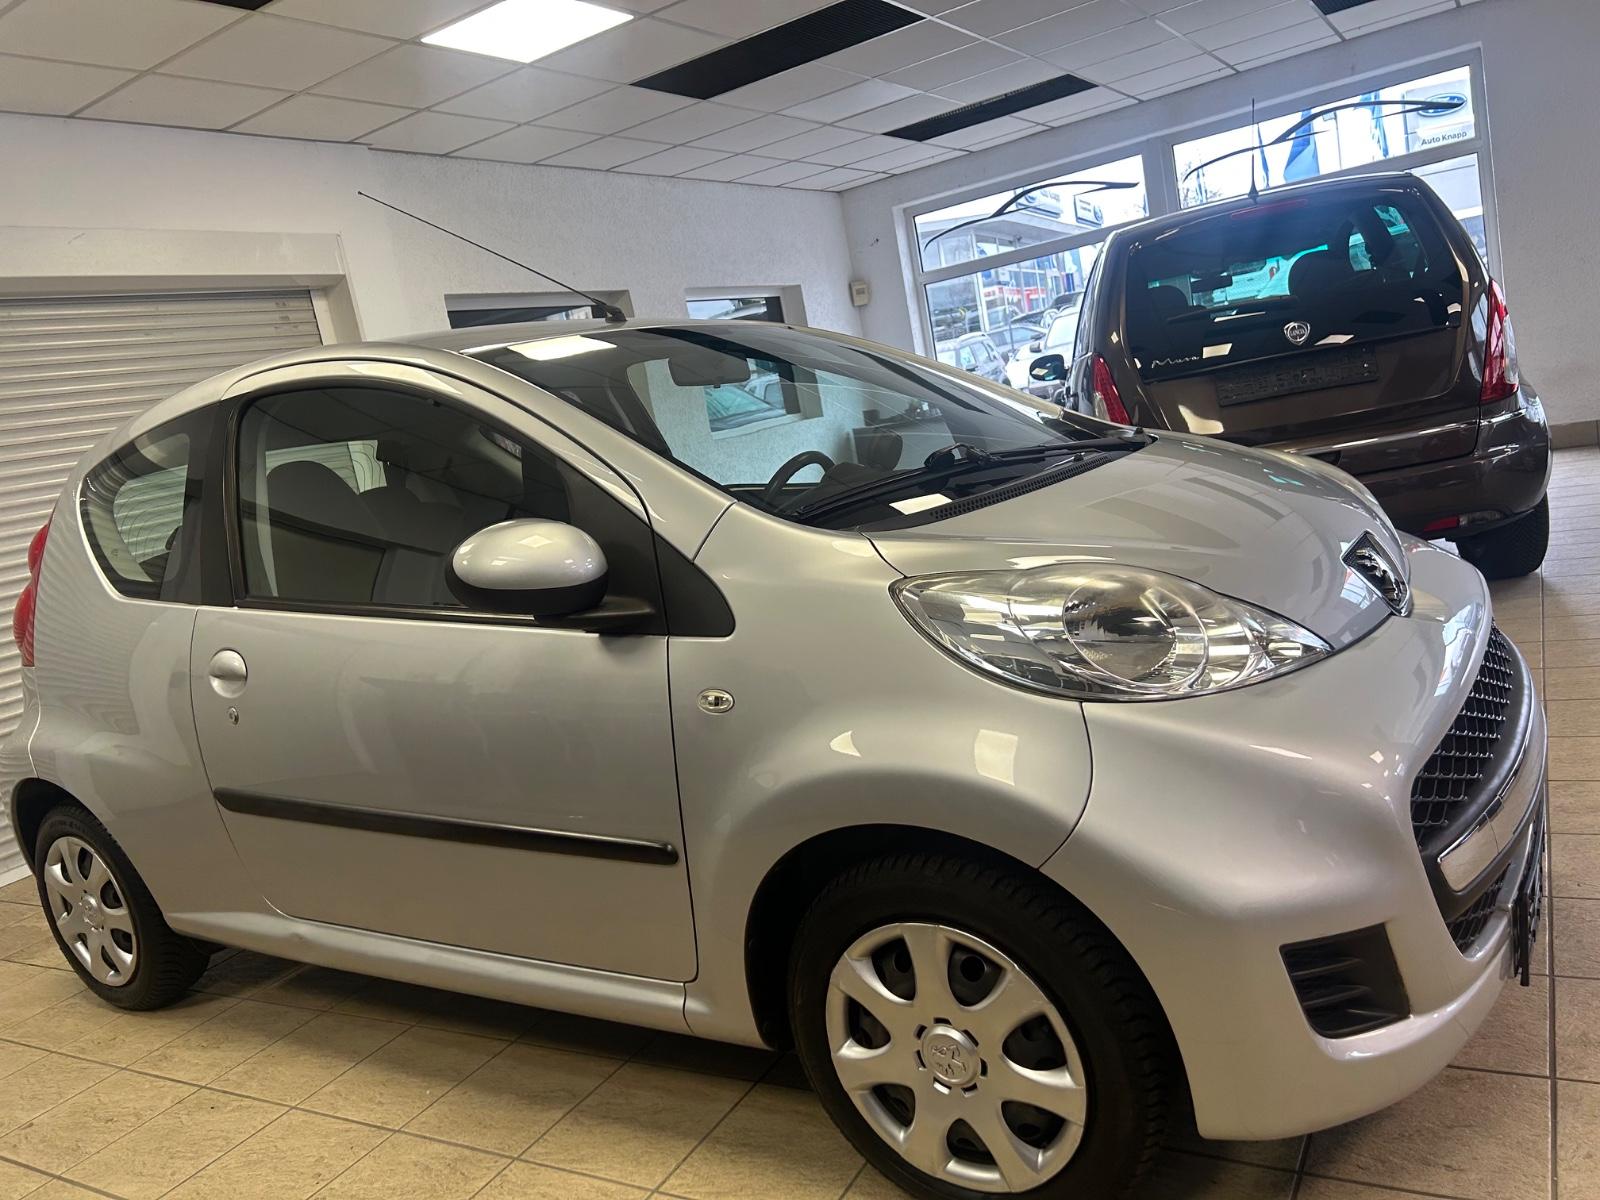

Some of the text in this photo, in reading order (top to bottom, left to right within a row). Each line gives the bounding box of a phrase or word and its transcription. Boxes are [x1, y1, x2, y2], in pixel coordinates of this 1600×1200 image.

[1421, 131, 1467, 145] Auto Knapp
[1151, 356, 1200, 369] Musa
